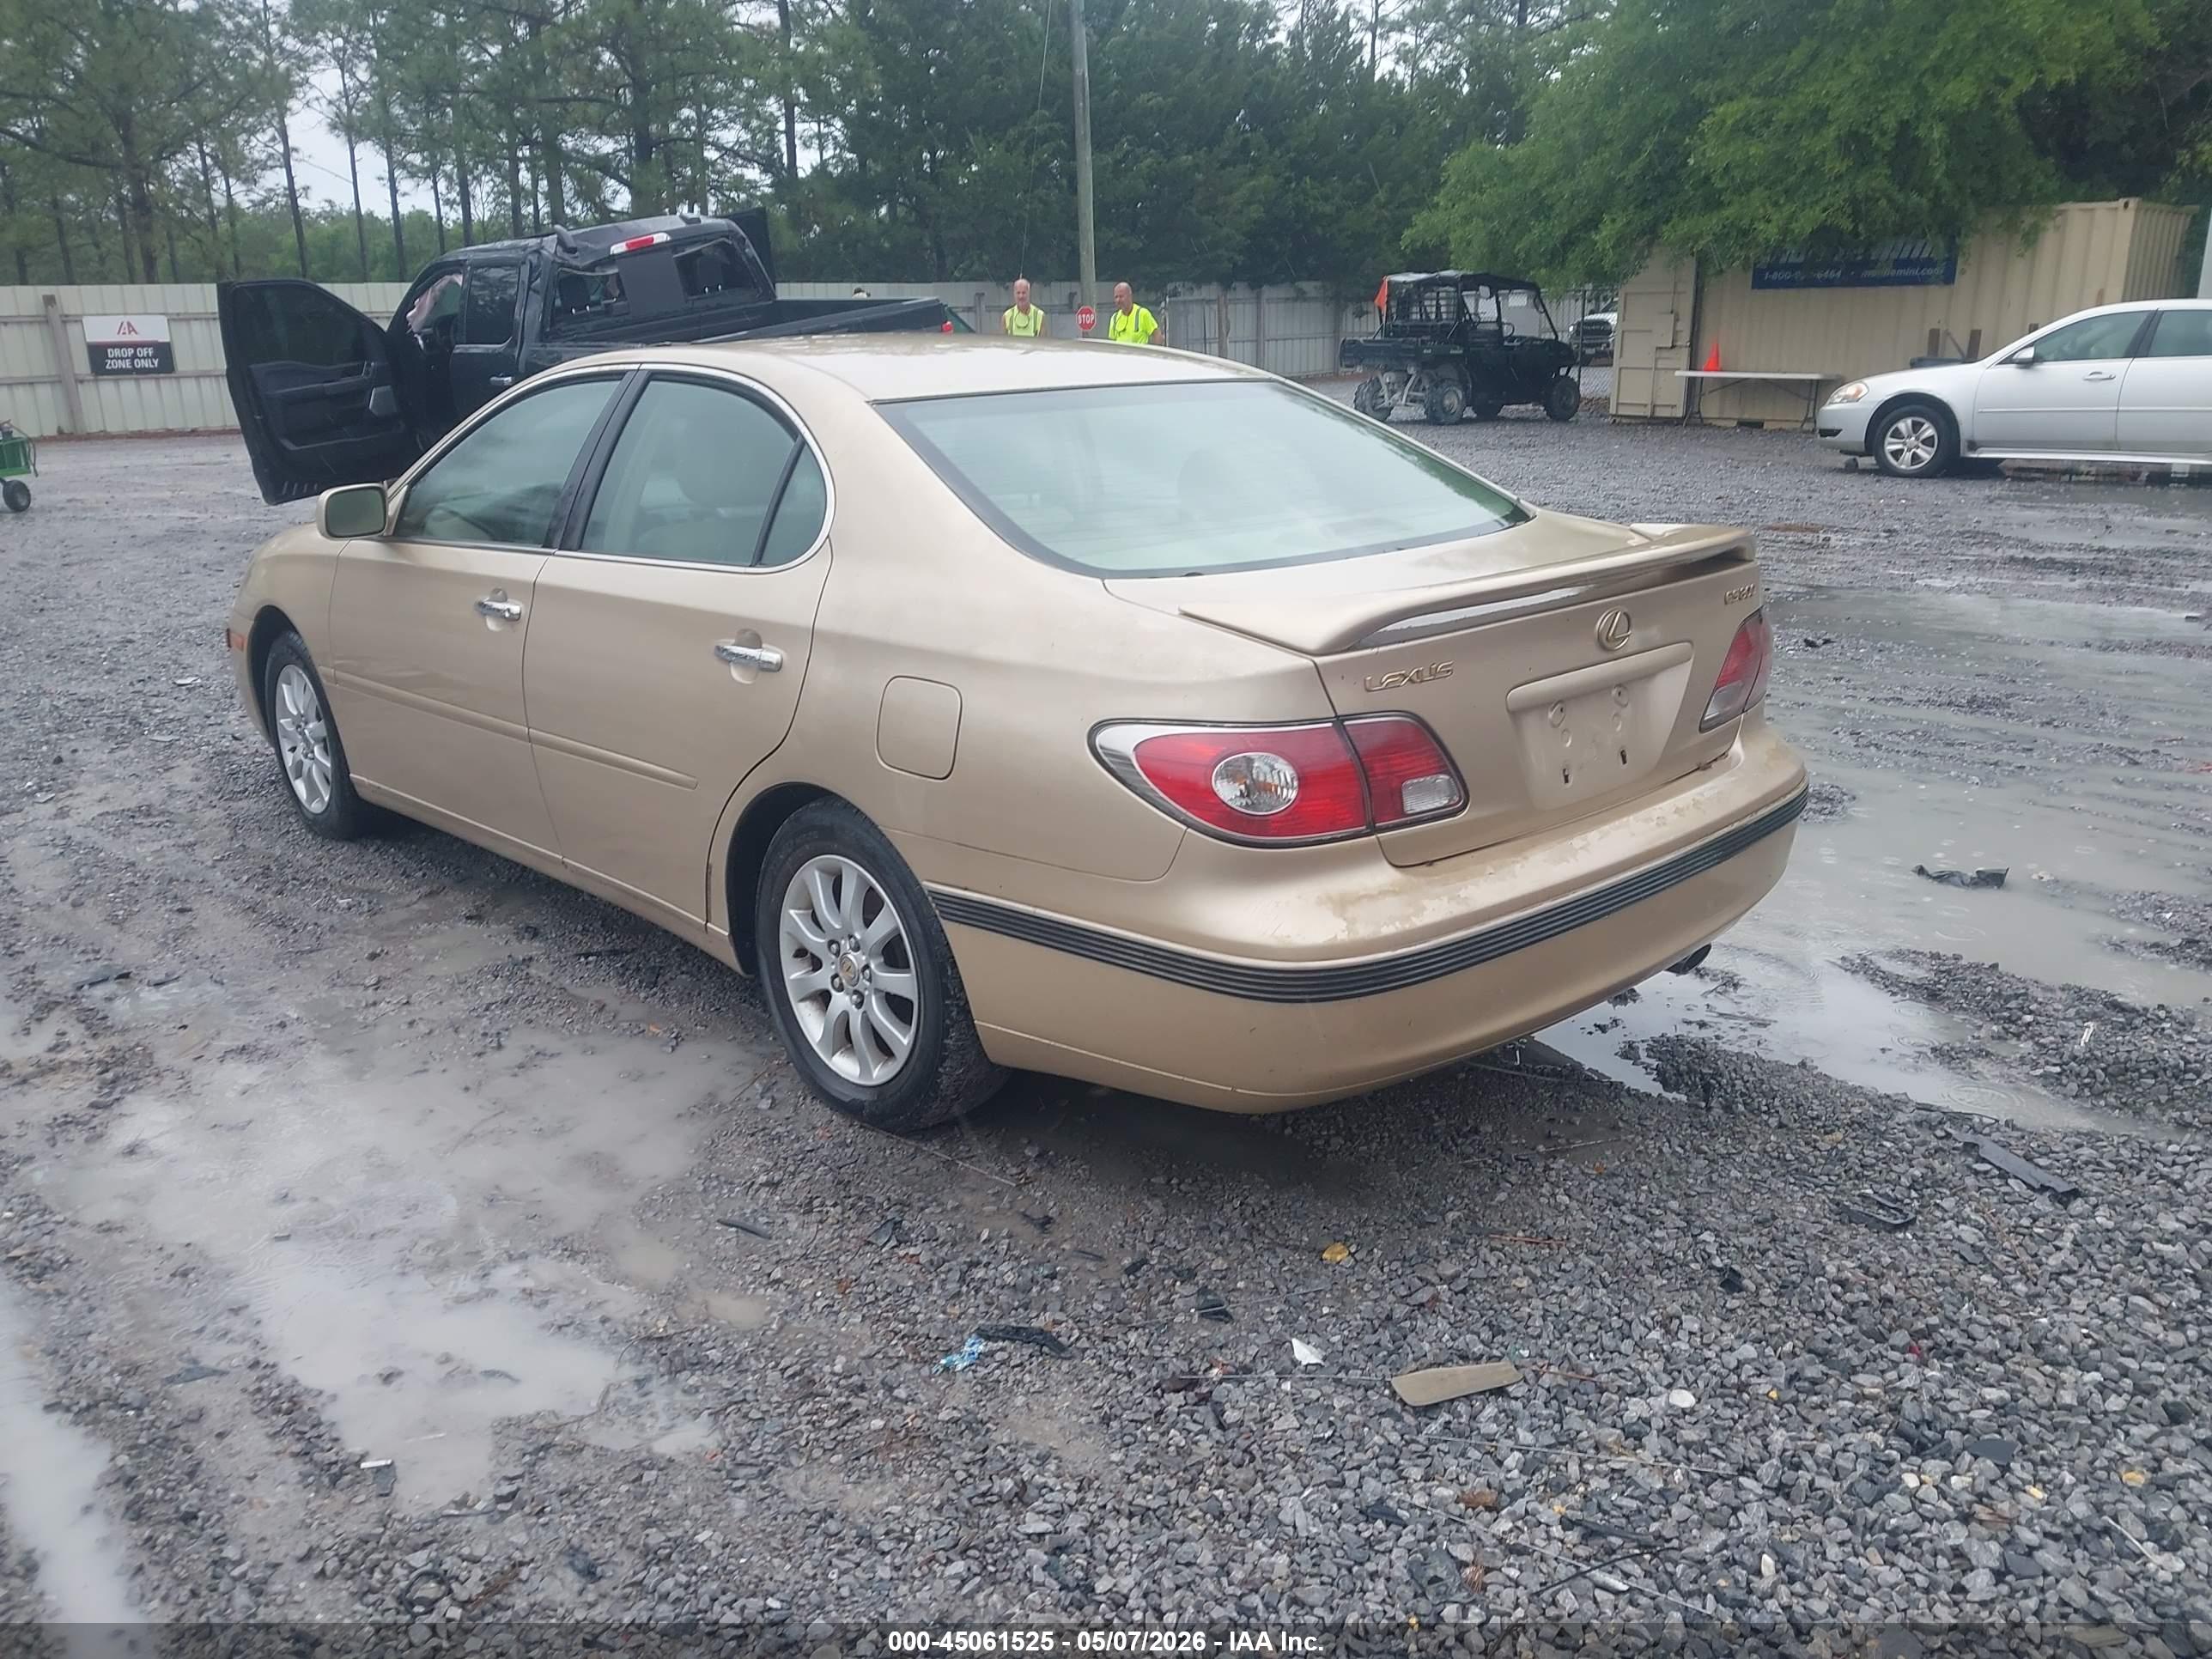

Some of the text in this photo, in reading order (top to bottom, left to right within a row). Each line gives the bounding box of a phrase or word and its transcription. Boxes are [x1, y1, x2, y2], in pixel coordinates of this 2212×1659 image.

[1079, 314, 1094, 324] STOP
[107, 347, 154, 357] DROP OFF
[105, 358, 159, 369] ZONE ONLY
[1364, 660, 1454, 693] LEXUS
